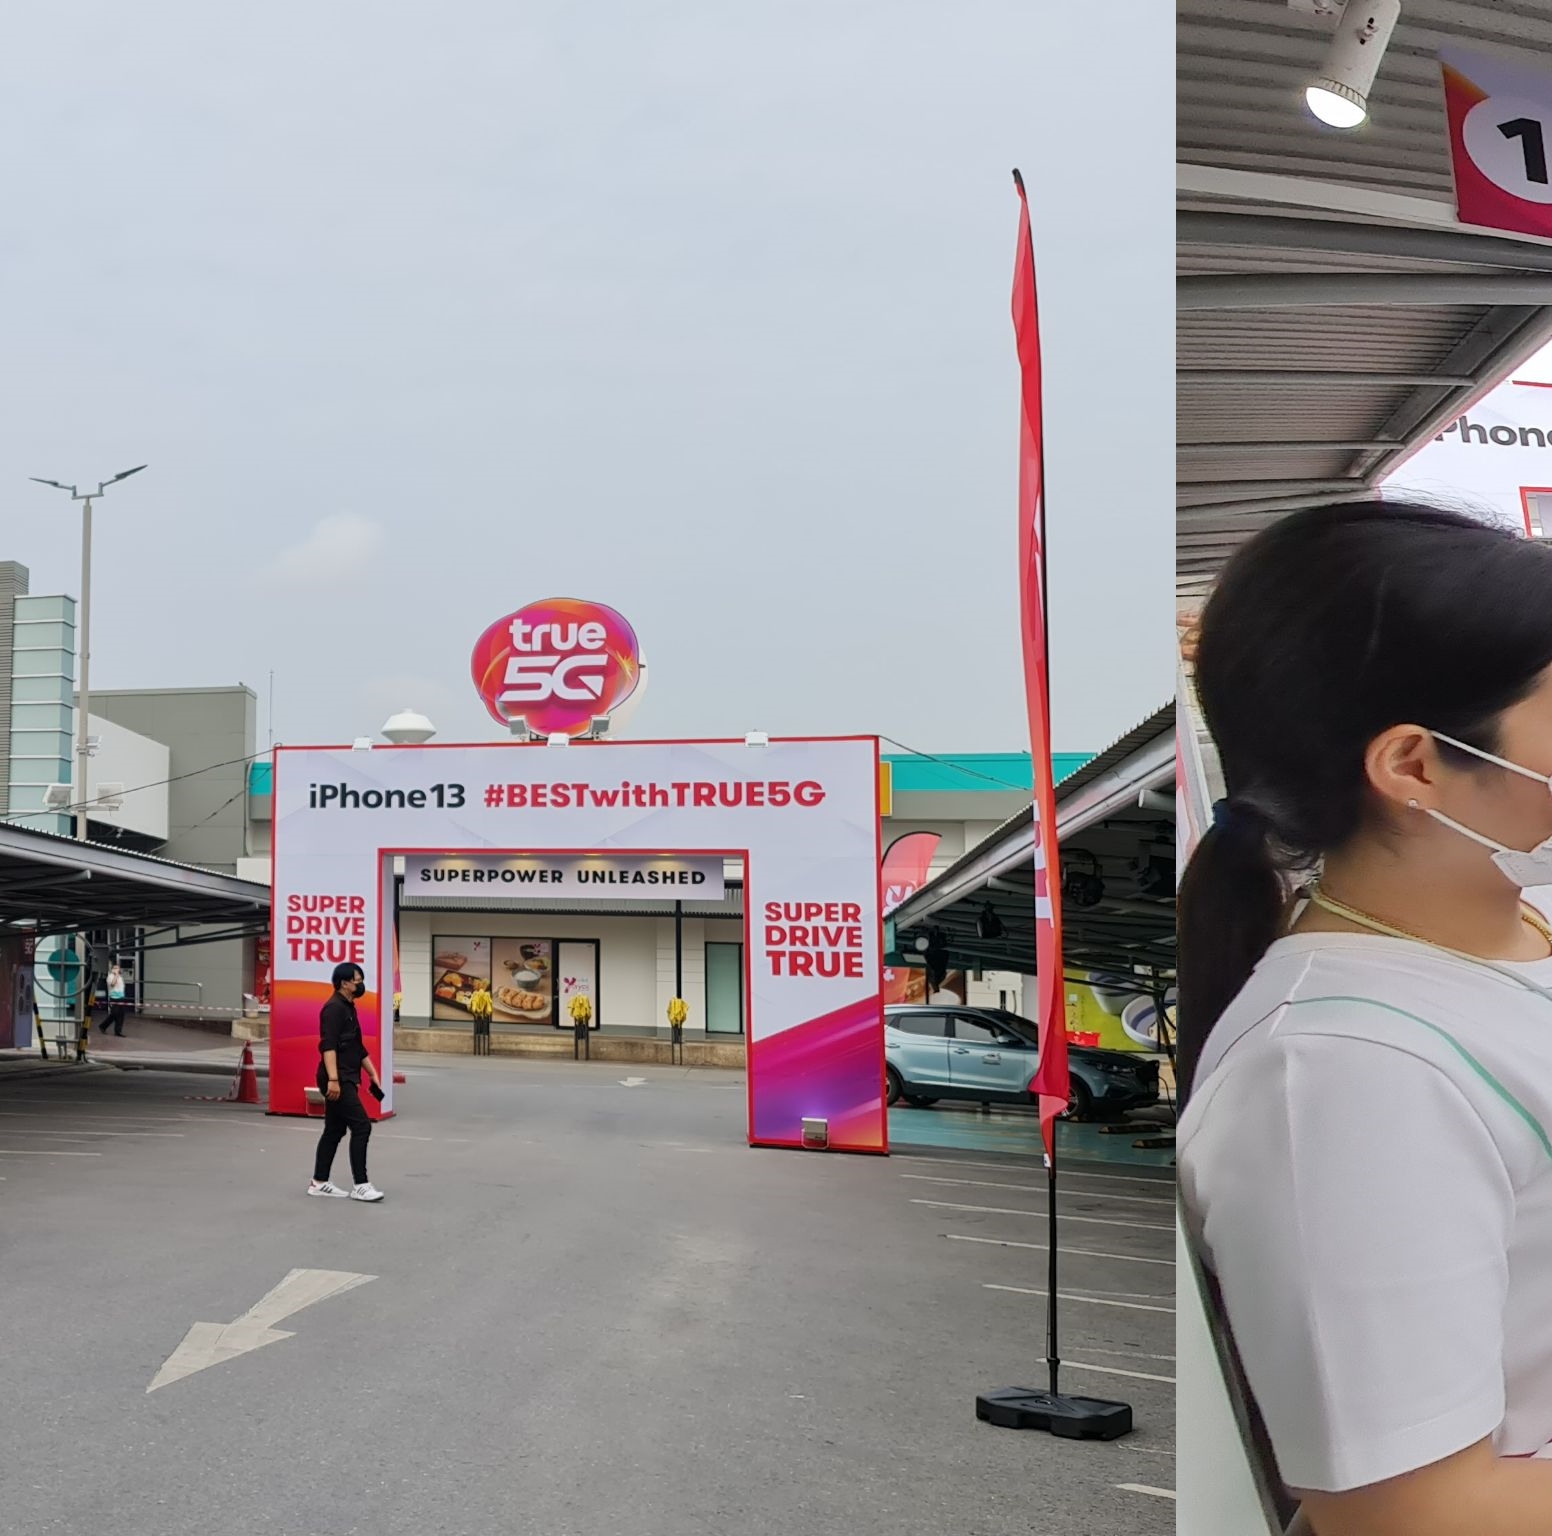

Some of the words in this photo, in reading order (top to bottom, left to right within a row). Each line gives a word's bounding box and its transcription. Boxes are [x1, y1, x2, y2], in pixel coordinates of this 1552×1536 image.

[1496, 117, 1549, 185] 1
[509, 618, 607, 652] true
[499, 654, 608, 702] 5G
[483, 780, 826, 809] #BESTwithTRUE5G
[419, 867, 564, 885] SUPERPOWER
[576, 869, 706, 886] UNLEASHED
[286, 894, 366, 914] SUPER
[764, 901, 863, 924] SUPER
[286, 915, 366, 937] DRIVE
[764, 924, 863, 948] DRIVE
[286, 938, 366, 964] TRUE
[765, 950, 864, 979] TRUE
